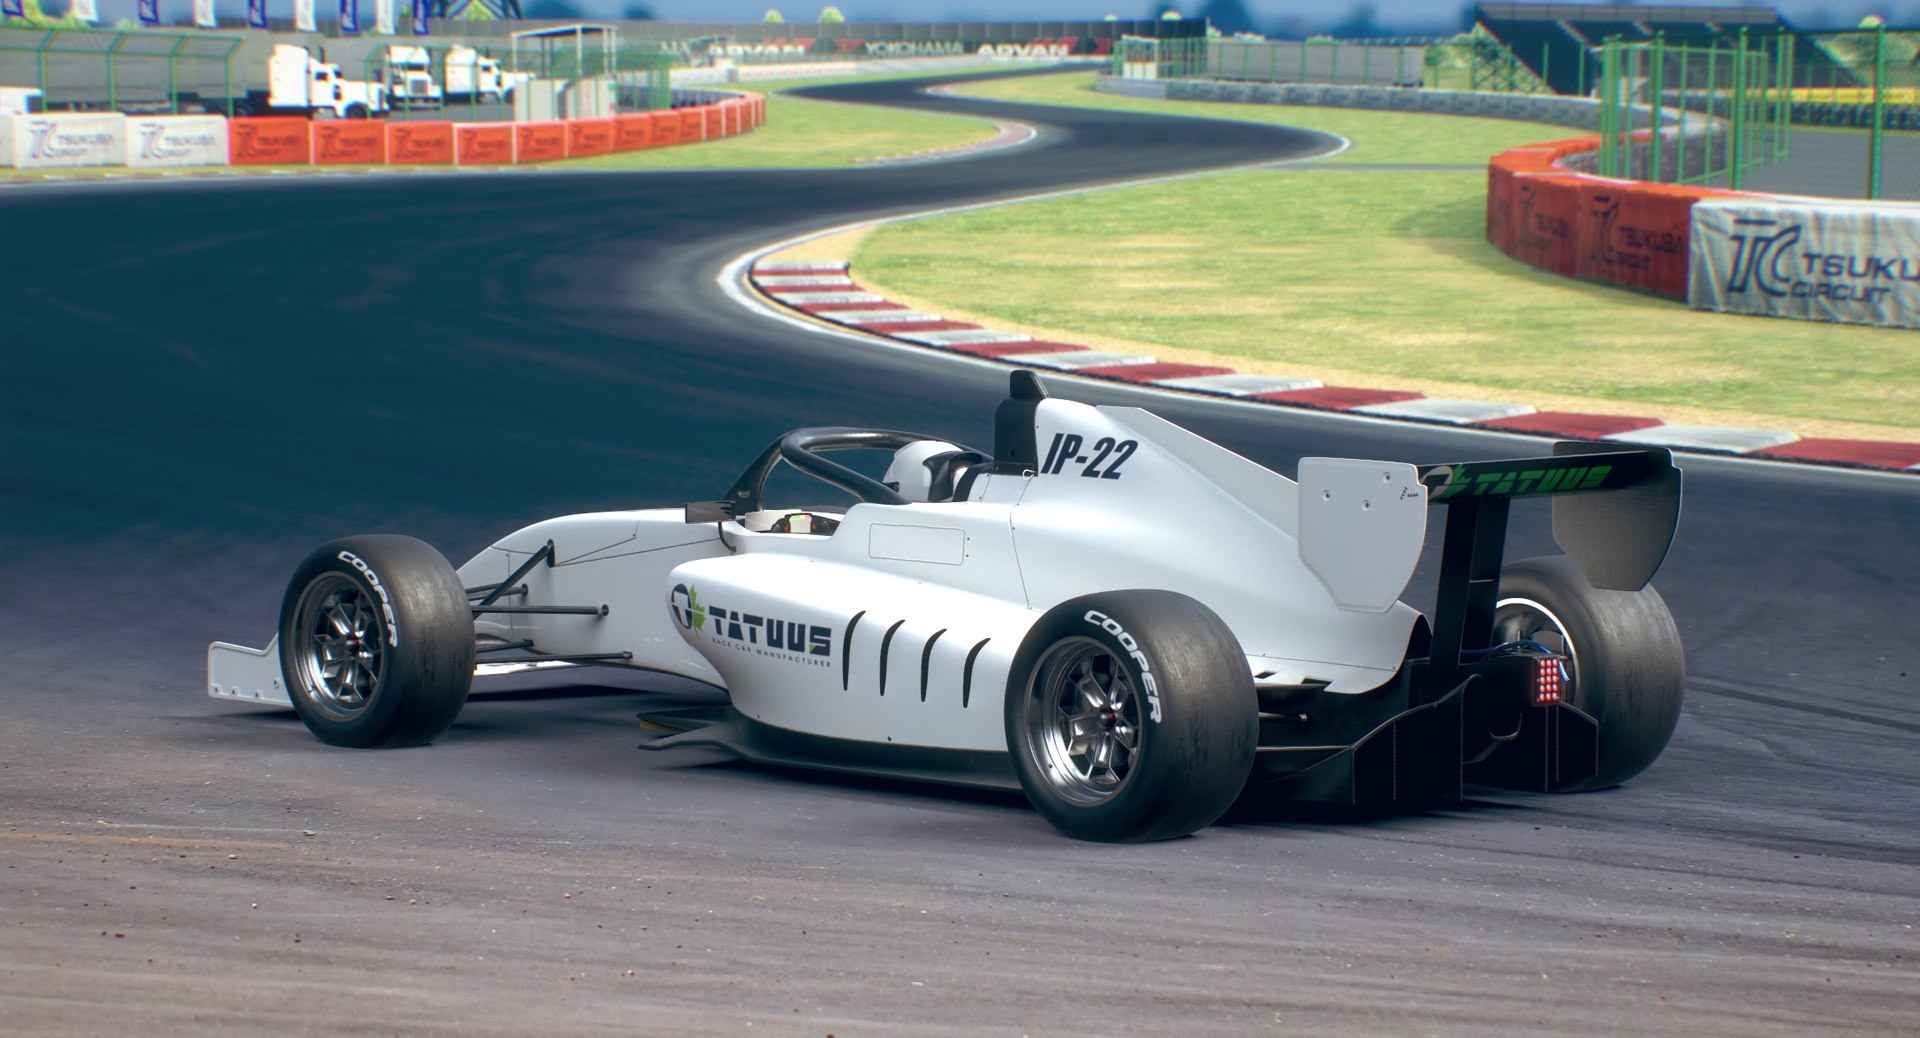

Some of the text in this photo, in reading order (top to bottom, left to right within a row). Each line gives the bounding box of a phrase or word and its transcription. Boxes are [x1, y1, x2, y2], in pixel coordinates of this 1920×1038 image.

[976, 43, 1069, 57] ADVAN
[1791, 280, 1893, 303] CIRCUIT
[1040, 432, 1139, 480] IP-22
[1473, 465, 1613, 497] TATUUS
[337, 550, 398, 648] COOPER
[708, 605, 832, 657] TATUUS
[711, 636, 831, 668] RACE CAR MANUFACTURER
[1083, 609, 1162, 724] COOPER
